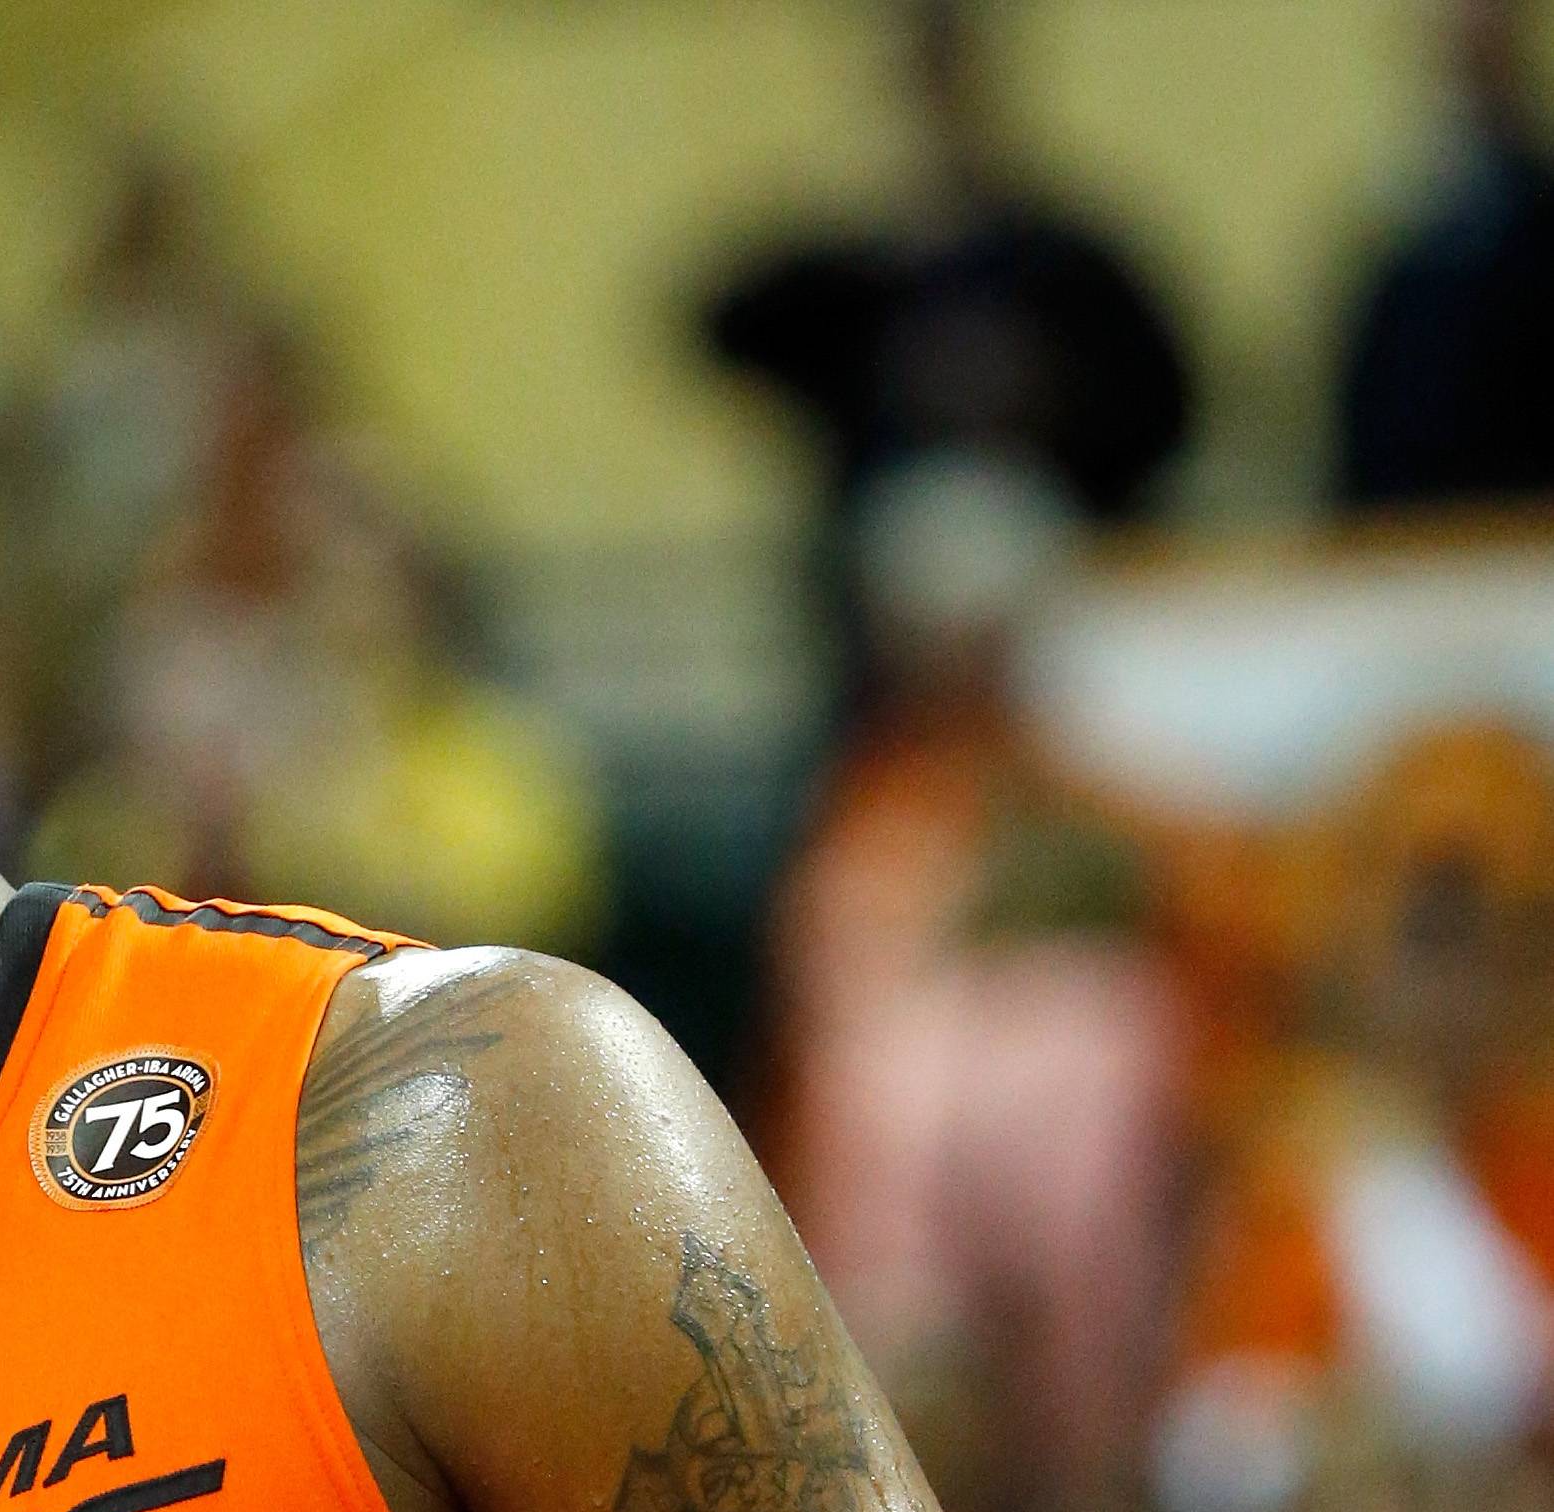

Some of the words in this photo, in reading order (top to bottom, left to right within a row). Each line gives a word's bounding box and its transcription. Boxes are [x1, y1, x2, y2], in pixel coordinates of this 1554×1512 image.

[54, 1060, 170, 1122] GALLAGHER-IBA
[171, 1065, 206, 1093] ARENA
[57, 1166, 93, 1196] 75TH
[92, 1128, 197, 1198] ANNIVERSARY
[85, 1089, 185, 1174] 75
